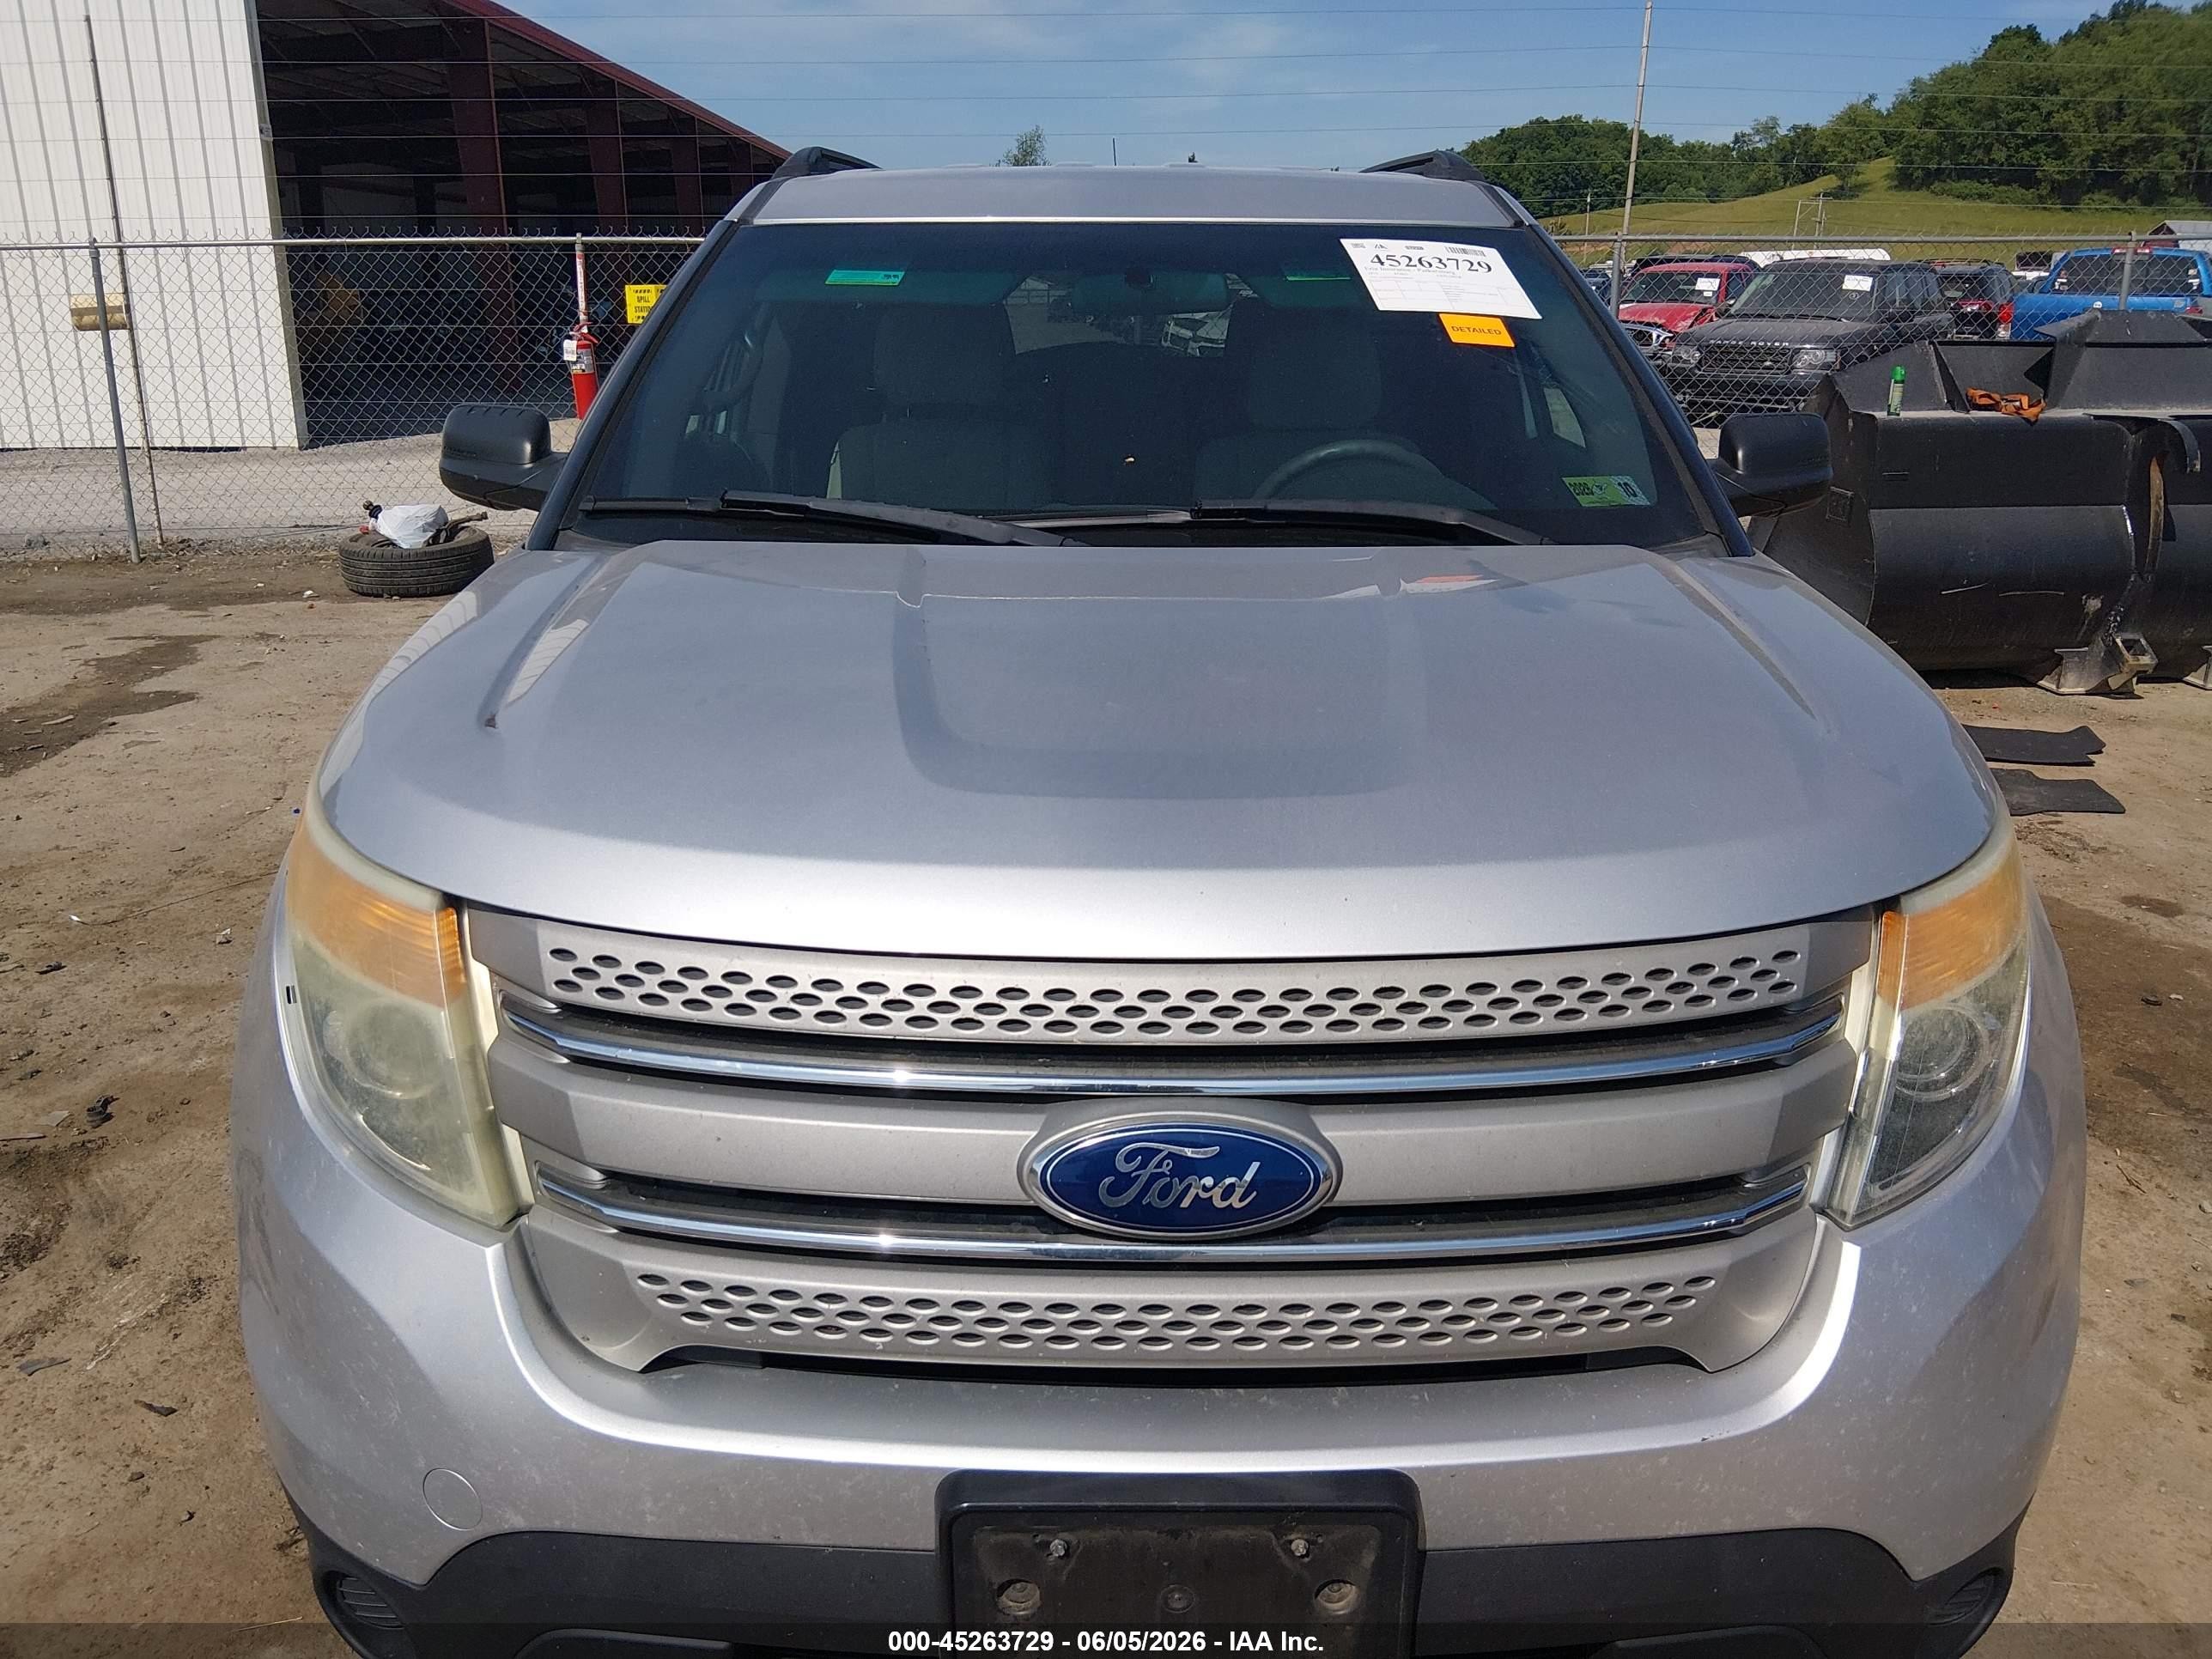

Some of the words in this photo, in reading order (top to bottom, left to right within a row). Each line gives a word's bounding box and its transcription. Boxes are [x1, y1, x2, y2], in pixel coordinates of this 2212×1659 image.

[1370, 252, 1492, 274] 45263729
[634, 305, 652, 313] STATIO
[1450, 325, 1501, 336] DETAILED
[1098, 1141, 1261, 1209] Ford
